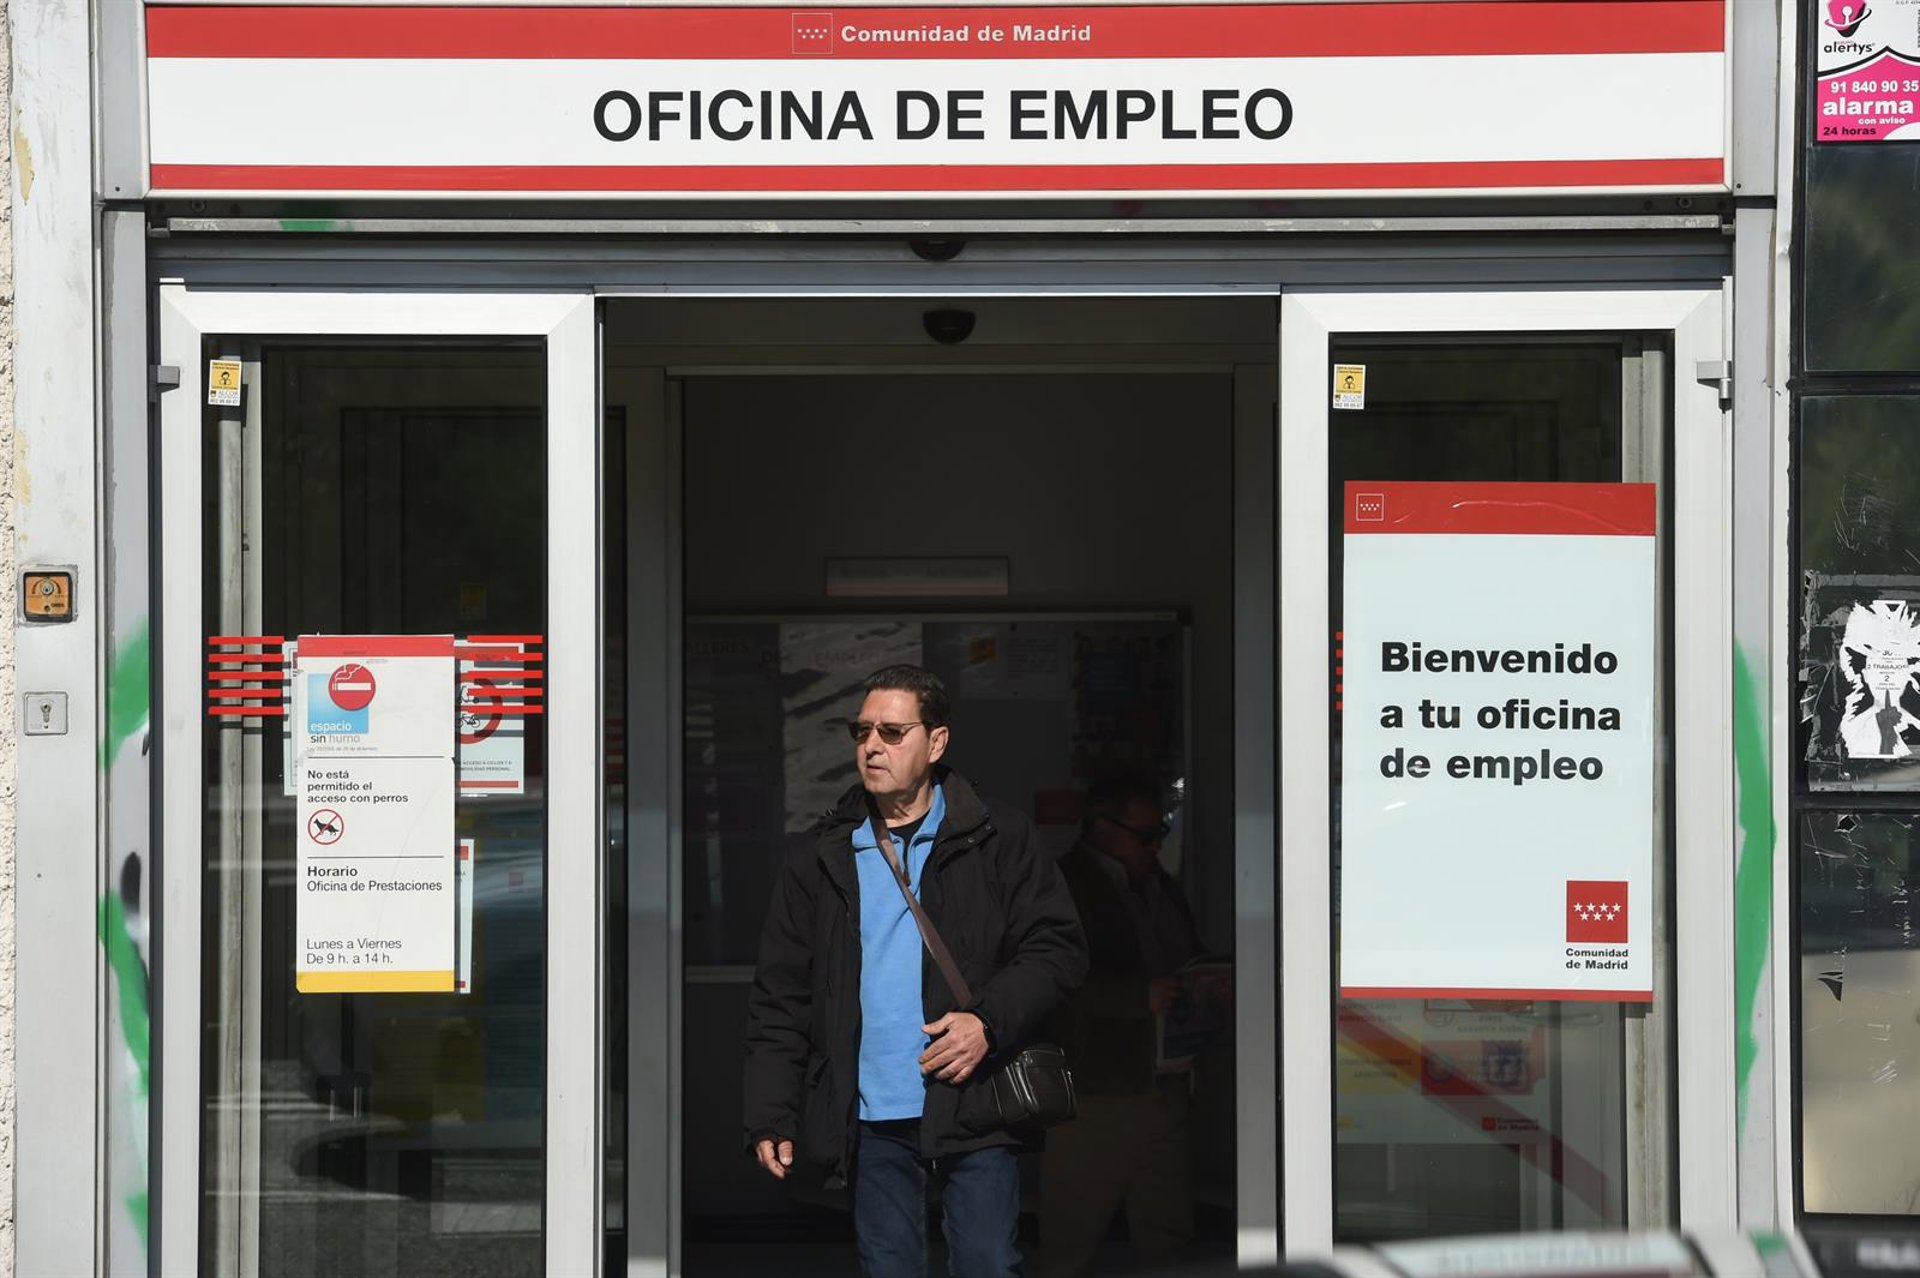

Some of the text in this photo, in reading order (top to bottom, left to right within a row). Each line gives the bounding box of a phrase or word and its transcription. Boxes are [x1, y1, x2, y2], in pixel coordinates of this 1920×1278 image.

[841, 24, 1091, 42] Comunidad de Madrid
[1824, 41, 1873, 55] alertys
[1831, 80, 1919, 93] 91 840 90 35
[1823, 97, 1914, 115] alarma
[593, 88, 1294, 142] OFICINA DE EMPLEO
[1858, 116, 1906, 125] con aviso
[1823, 126, 1876, 136] 24 horas
[1381, 641, 1618, 674] Bienvenido
[1380, 698, 1621, 731] a tu oficina
[310, 720, 352, 733] espacio
[310, 732, 361, 744] sin humo
[1380, 748, 1604, 786] de empleo
[307, 769, 349, 779] No está
[307, 781, 373, 792] permitido el
[307, 795, 409, 805] acceso con perros
[307, 865, 359, 877] Horario
[306, 880, 442, 892] Oficina de Prestaciones
[306, 938, 401, 950] Lunes a Viernes
[306, 953, 393, 964] De 9 h. a 14 h.
[1565, 947, 1629, 958] Comunidad
[1565, 959, 1628, 969] de Madrid
